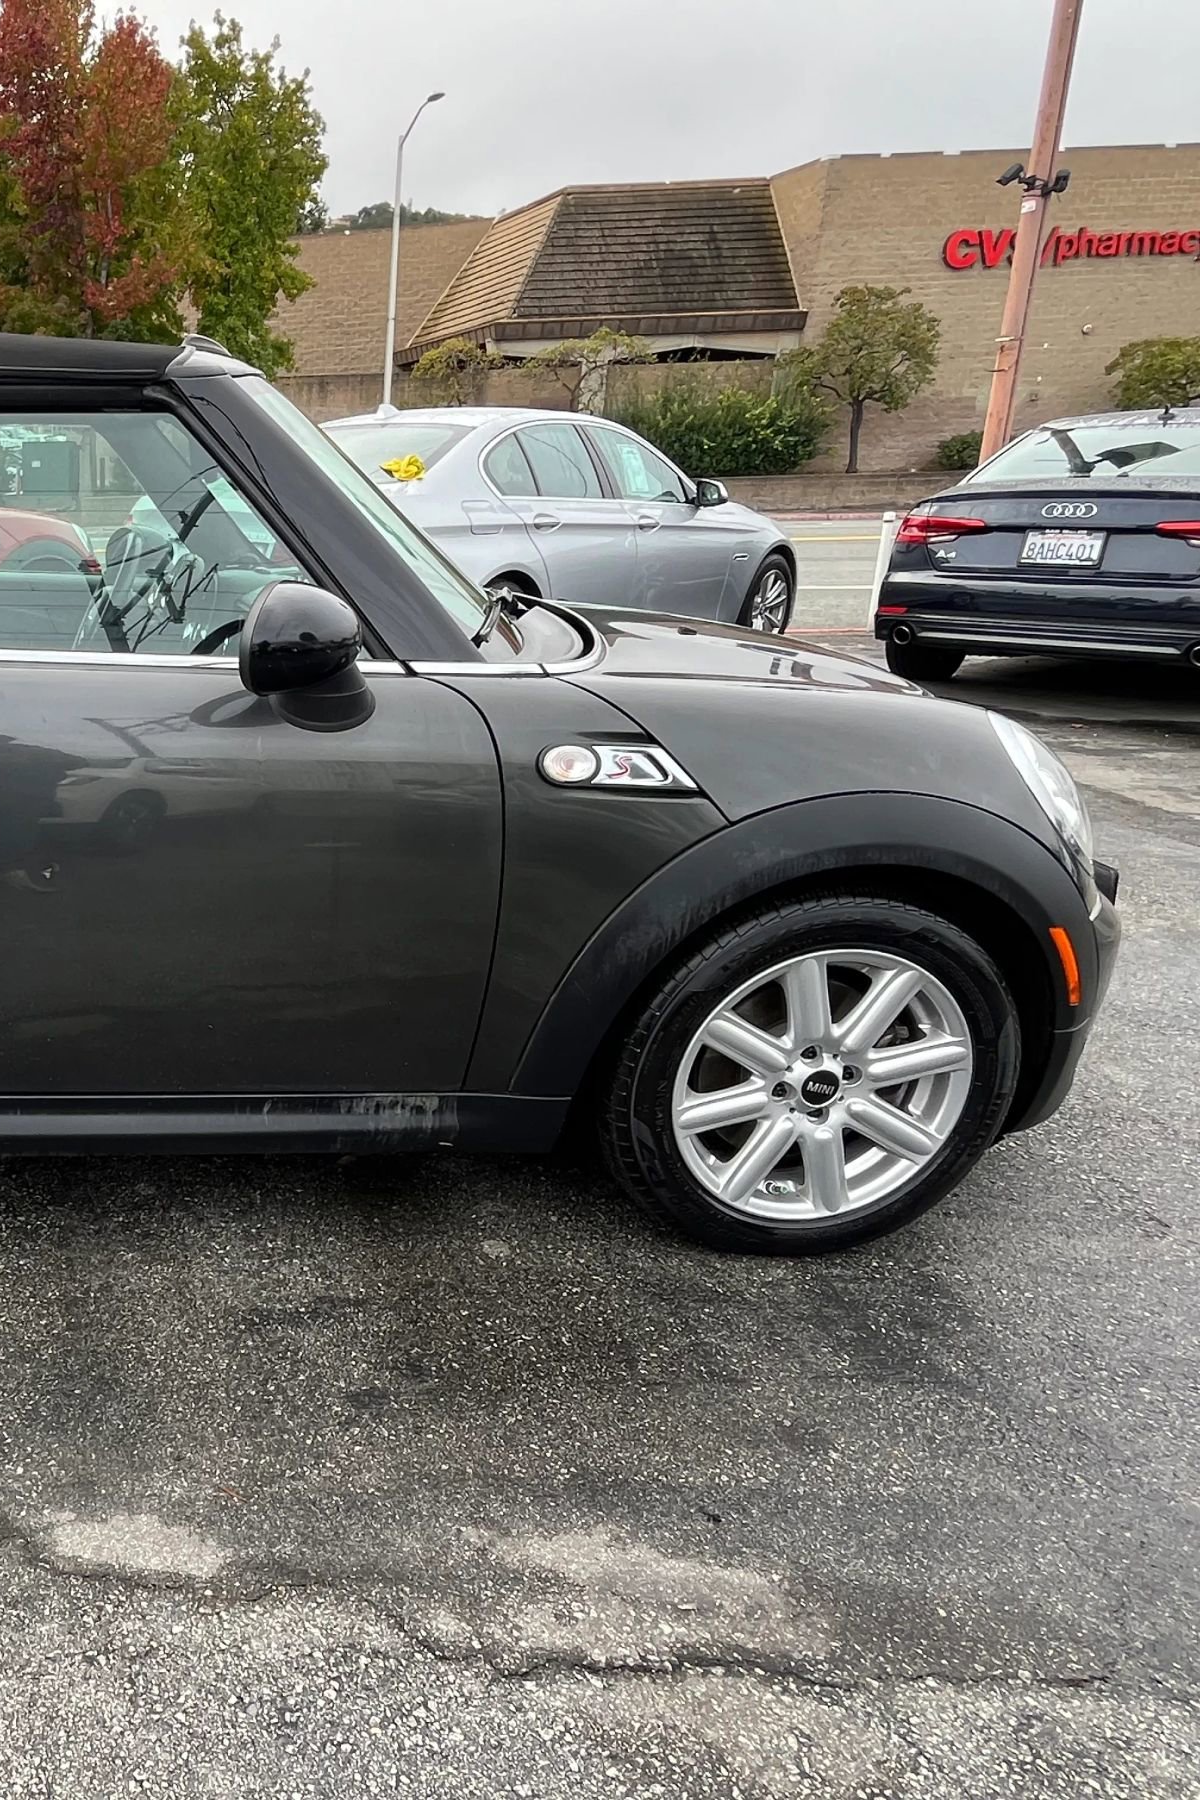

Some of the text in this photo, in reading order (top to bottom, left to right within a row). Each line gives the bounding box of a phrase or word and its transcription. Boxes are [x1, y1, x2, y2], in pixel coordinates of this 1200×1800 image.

[944, 229, 1017, 269] CV
[935, 549, 957, 559] A4
[806, 1080, 835, 1096] MINI
